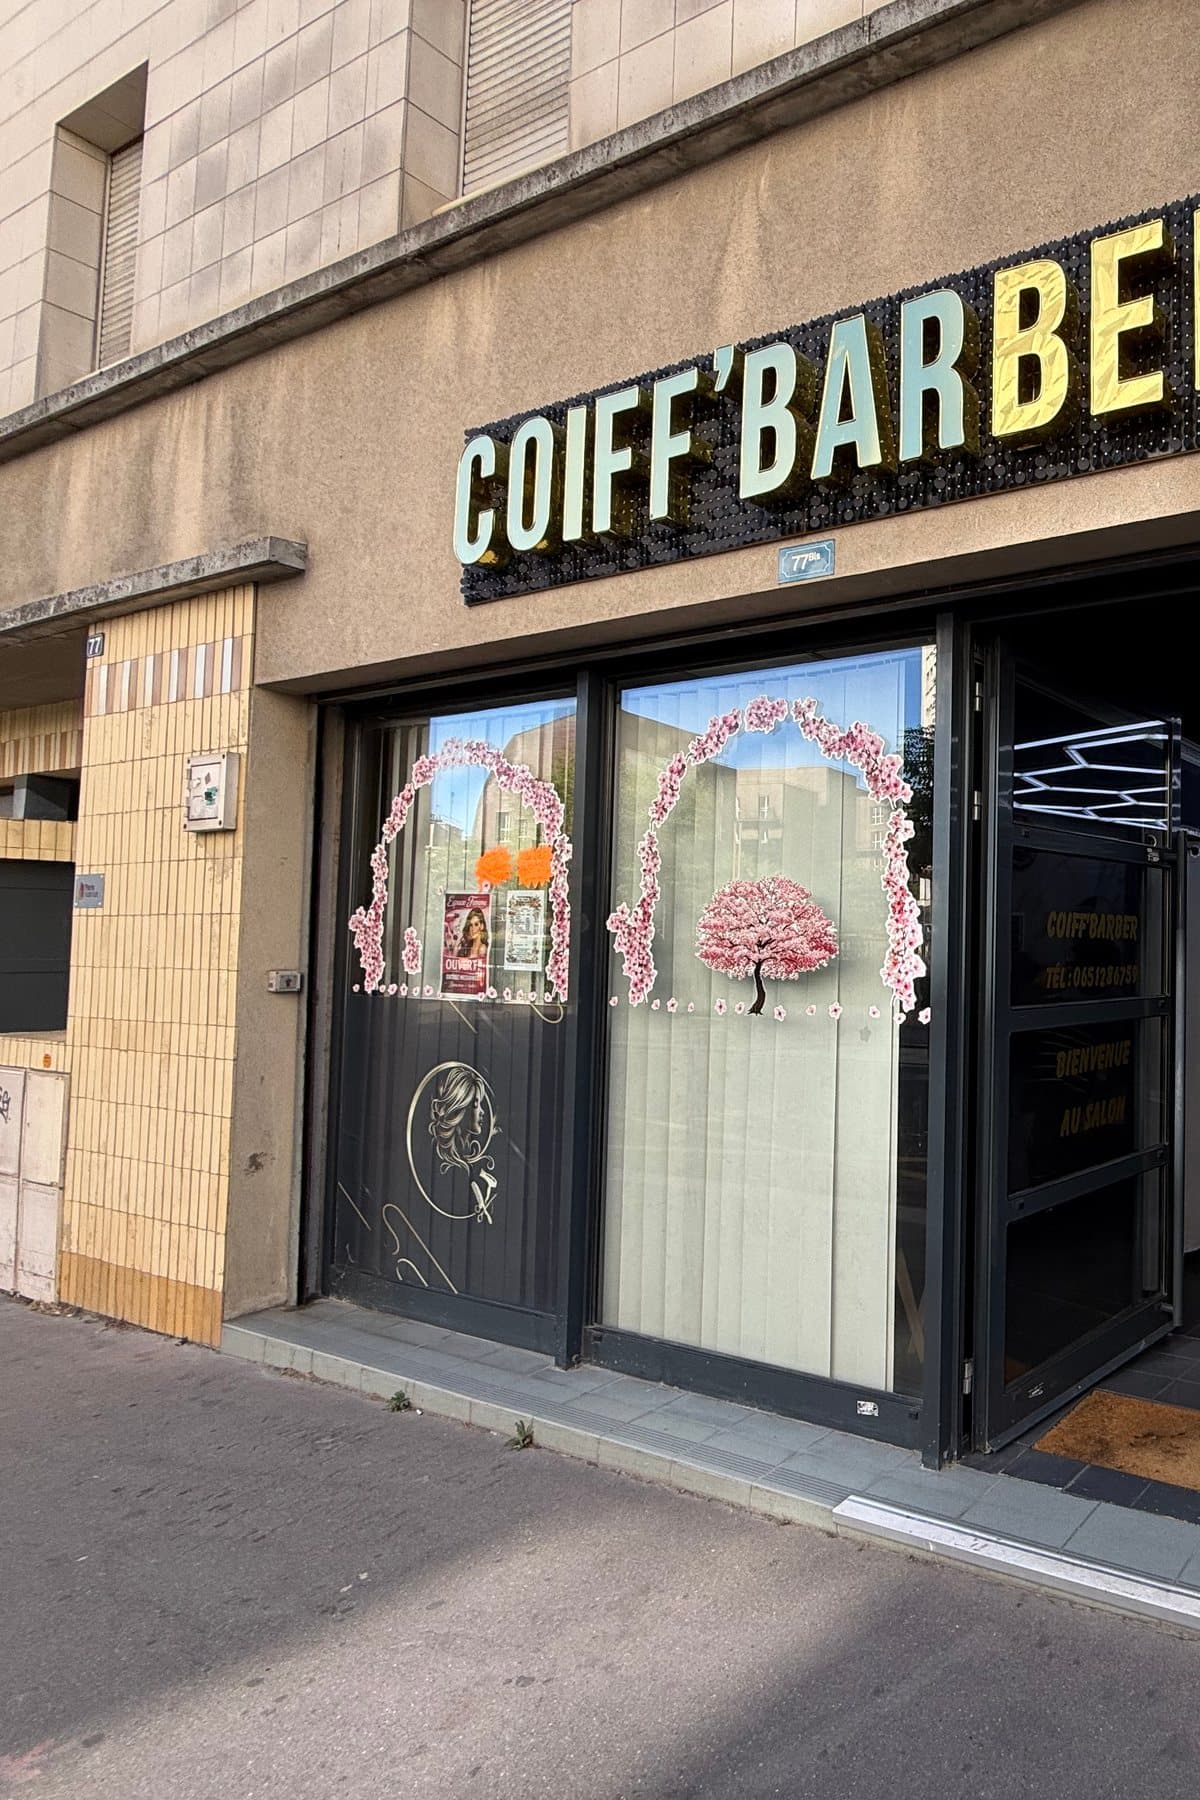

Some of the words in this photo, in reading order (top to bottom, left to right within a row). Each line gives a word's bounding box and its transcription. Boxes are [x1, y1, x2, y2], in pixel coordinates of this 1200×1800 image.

[89, 637, 101, 655] 77
[1056, 1040, 1131, 1078] BIENVENUE
[1060, 1106, 1082, 1137] AU
[1081, 1096, 1126, 1131] SALON
